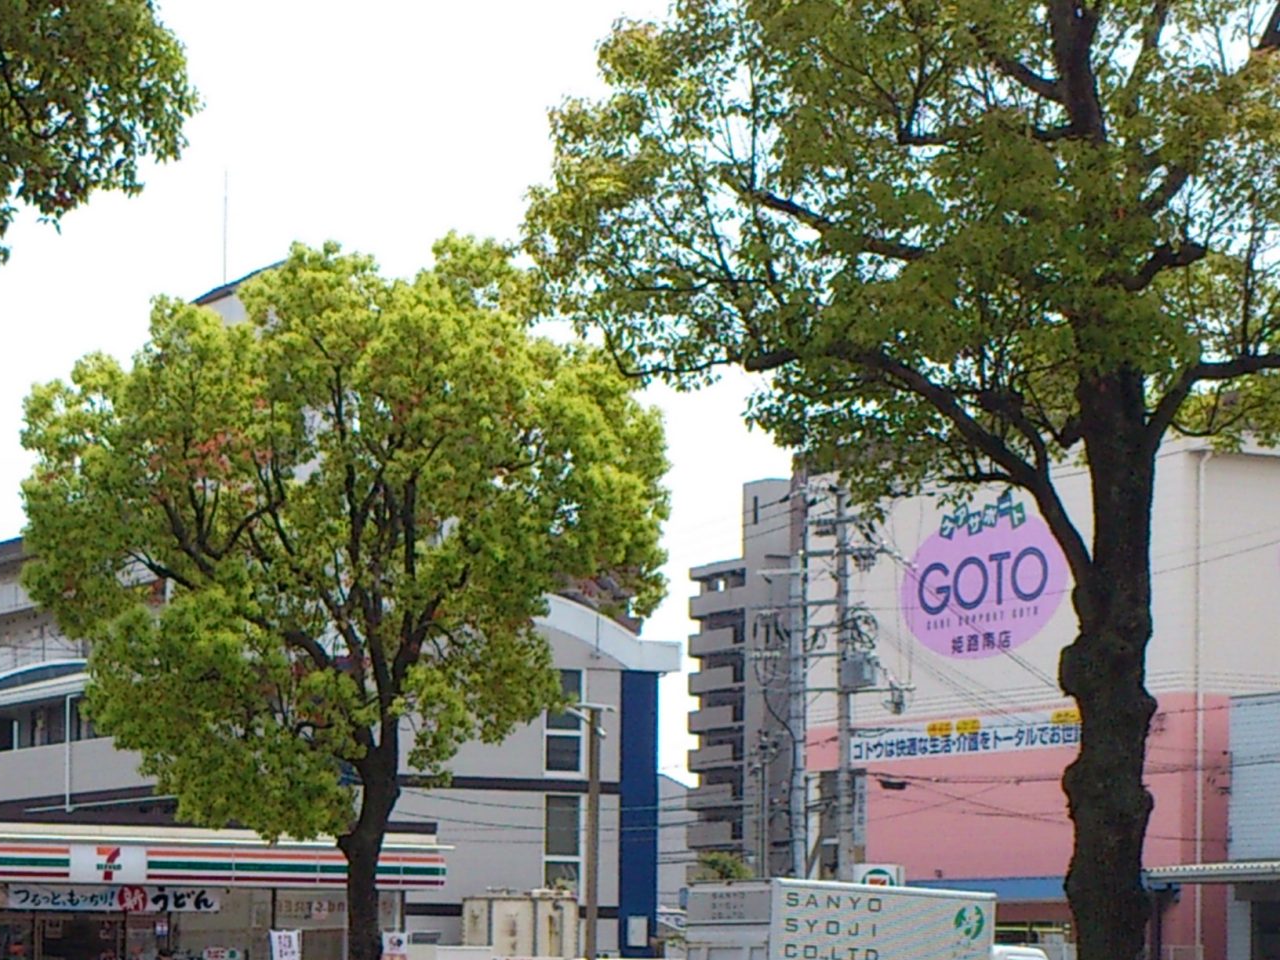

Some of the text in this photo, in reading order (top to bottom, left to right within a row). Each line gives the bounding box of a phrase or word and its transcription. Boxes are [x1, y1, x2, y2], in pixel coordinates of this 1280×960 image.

[918, 546, 1049, 616] GOTO
[151, 886, 214, 911] うどん
[785, 892, 882, 912] SANYO
[785, 918, 876, 937] SYOJI
